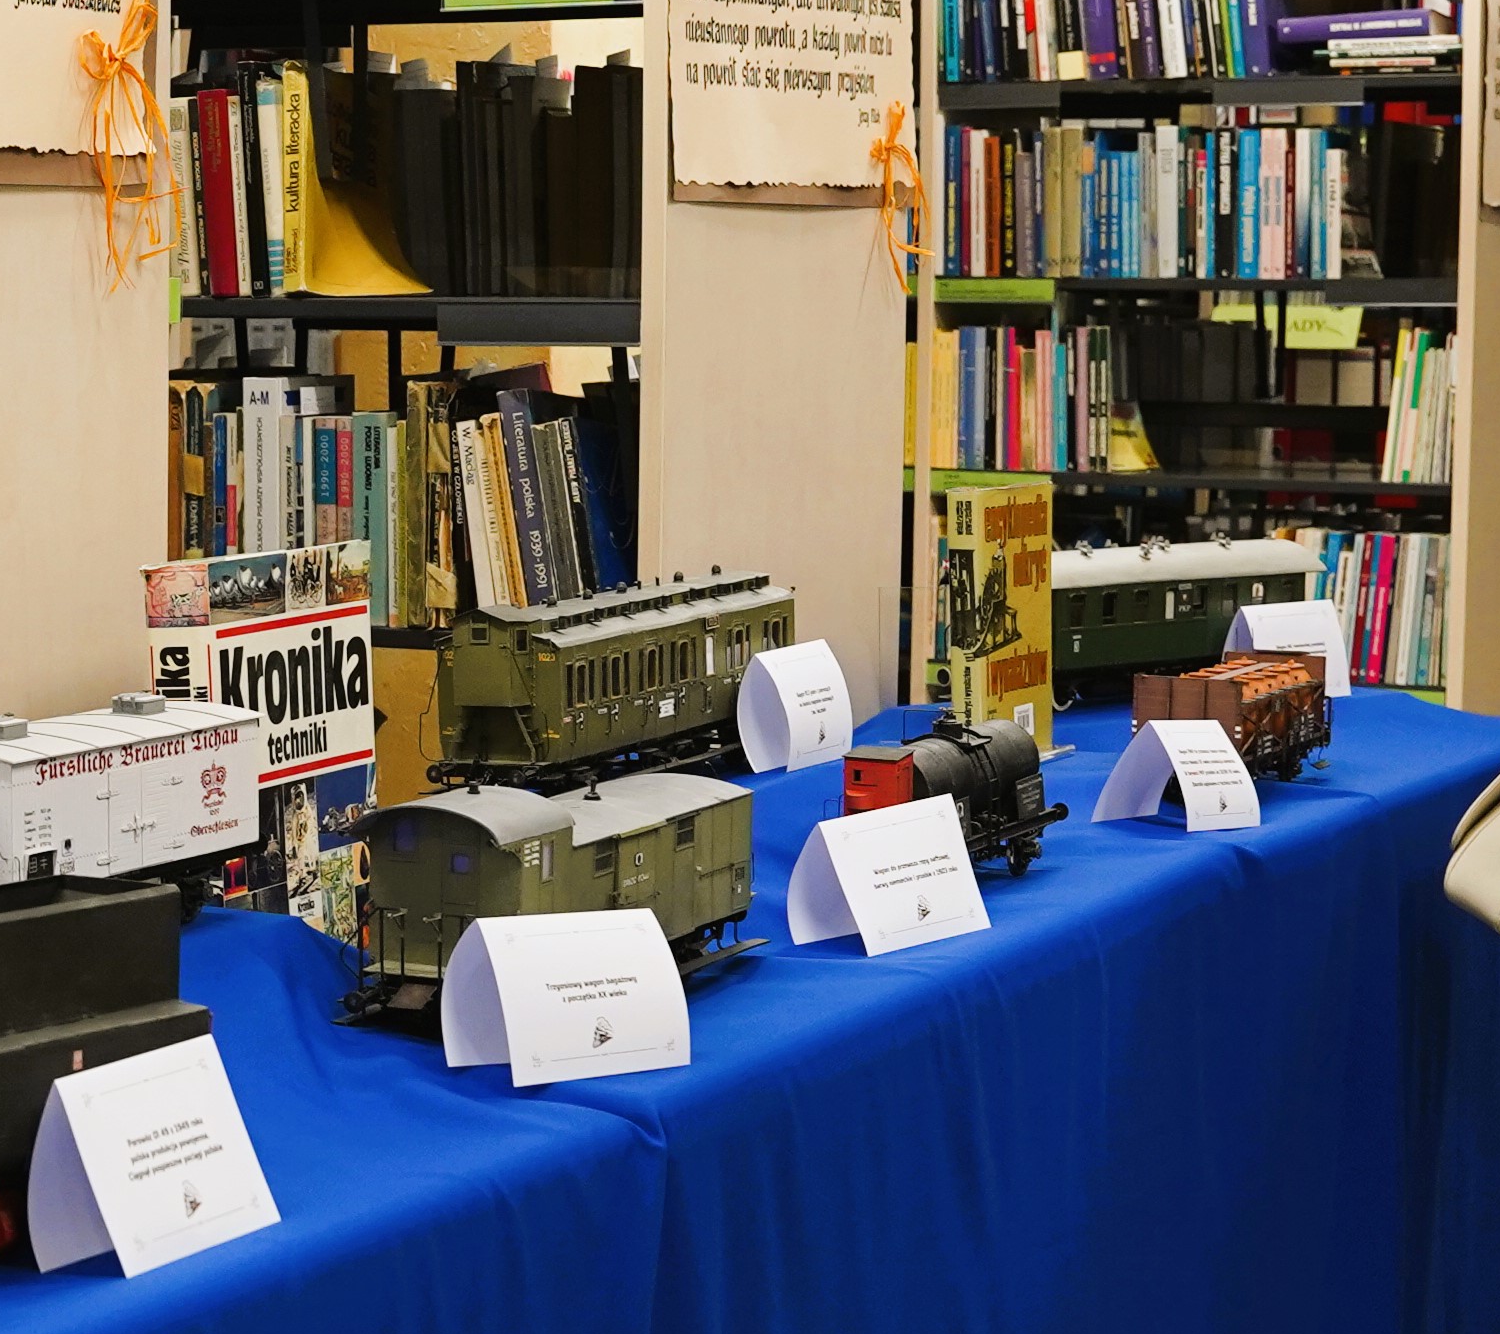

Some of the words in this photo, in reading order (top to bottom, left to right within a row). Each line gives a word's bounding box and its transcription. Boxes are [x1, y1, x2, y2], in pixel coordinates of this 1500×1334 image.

[686, 16, 749, 52] nieustannego
[686, 61, 698, 84] na
[703, 57, 736, 90] powrót
[742, 60, 760, 88] stać
[765, 61, 780, 92] się
[784, 64, 831, 98] pierwszym
[285, 93, 300, 156] literacka
[285, 160, 300, 213] kultura
[250, 390, 269, 405] A-M
[462, 427, 472, 442] W.
[512, 411, 529, 472] Literatura
[320, 435, 329, 497] 1990-2000
[464, 445, 474, 485] Maciąg
[520, 478, 535, 519] polska
[529, 530, 548, 588] 1939-1991
[219, 626, 369, 724] Kronika
[35, 749, 113, 786] Fürstliche
[121, 734, 185, 767] Brauerei
[191, 727, 238, 751] Tichau
[268, 720, 327, 766] techniki
[190, 817, 238, 837] Oberschlesien
[584, 980, 604, 988] wagon
